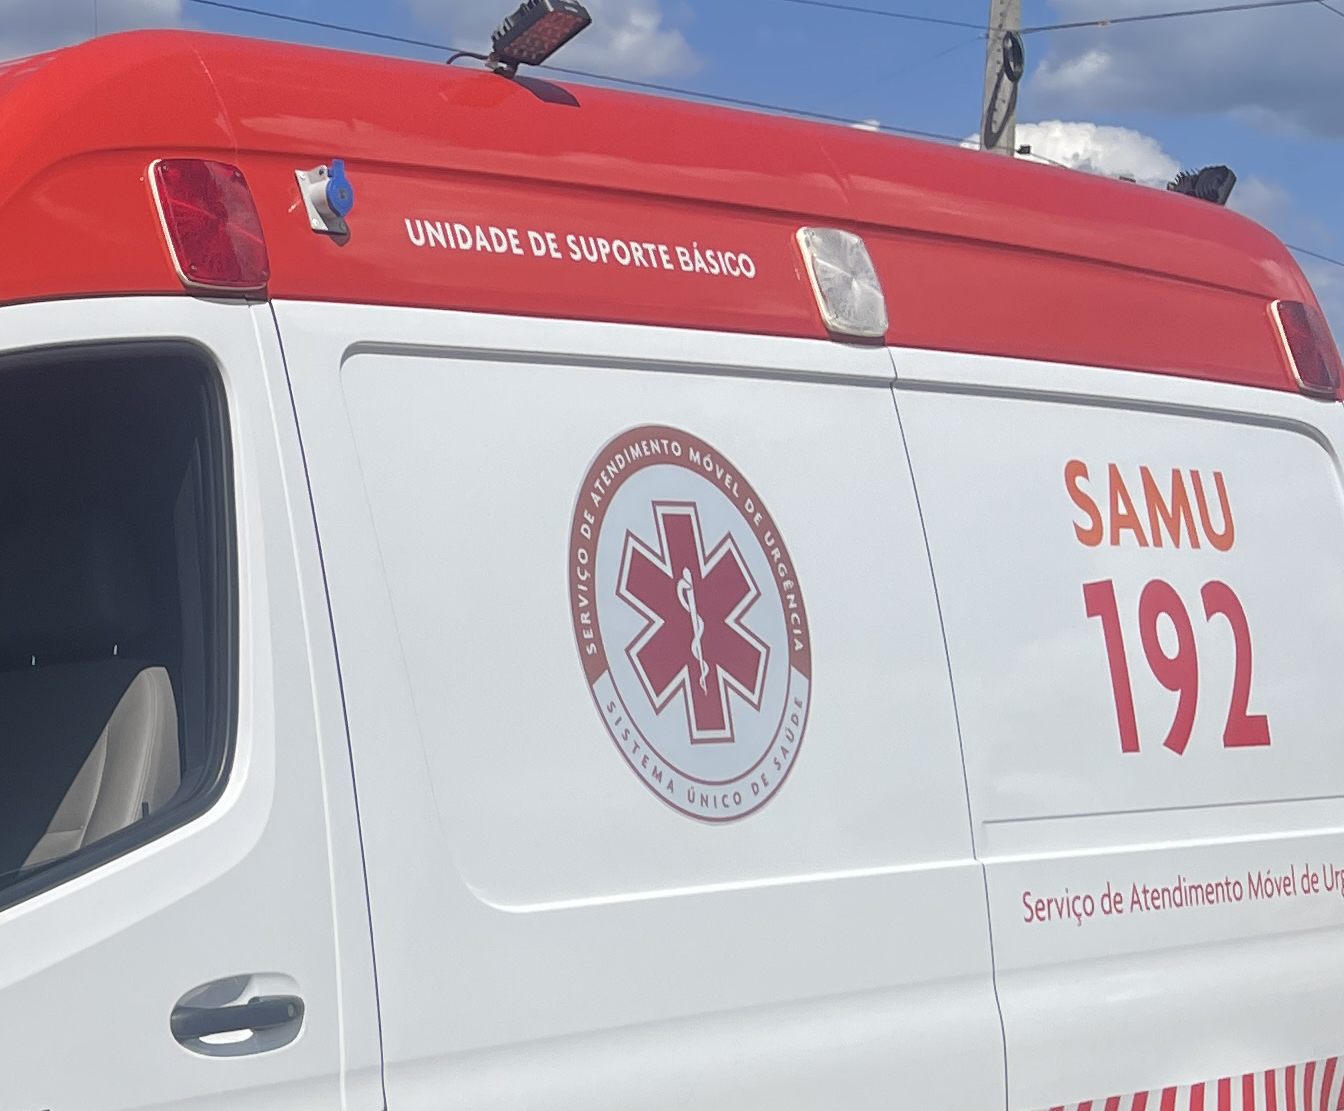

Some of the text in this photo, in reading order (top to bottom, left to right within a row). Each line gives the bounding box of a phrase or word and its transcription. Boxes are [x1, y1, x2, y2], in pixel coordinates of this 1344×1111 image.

[404, 218, 756, 278] UNIDADE DE SUPORTE BÁSICO
[577, 439, 803, 655] SERVIÇO DE ATENDIMENTO MÓVEL DE URGÊNCIA
[1064, 459, 1234, 552] SAMU
[1083, 579, 1271, 756] 192
[606, 697, 803, 809] SISTEMA ÚNICO DE SAÚDE
[1023, 887, 1095, 926] Serviço
[1100, 882, 1123, 915] de
[1130, 875, 1243, 914] Atendimento
[1247, 864, 1297, 900] Móvel
[1300, 863, 1319, 894] de
